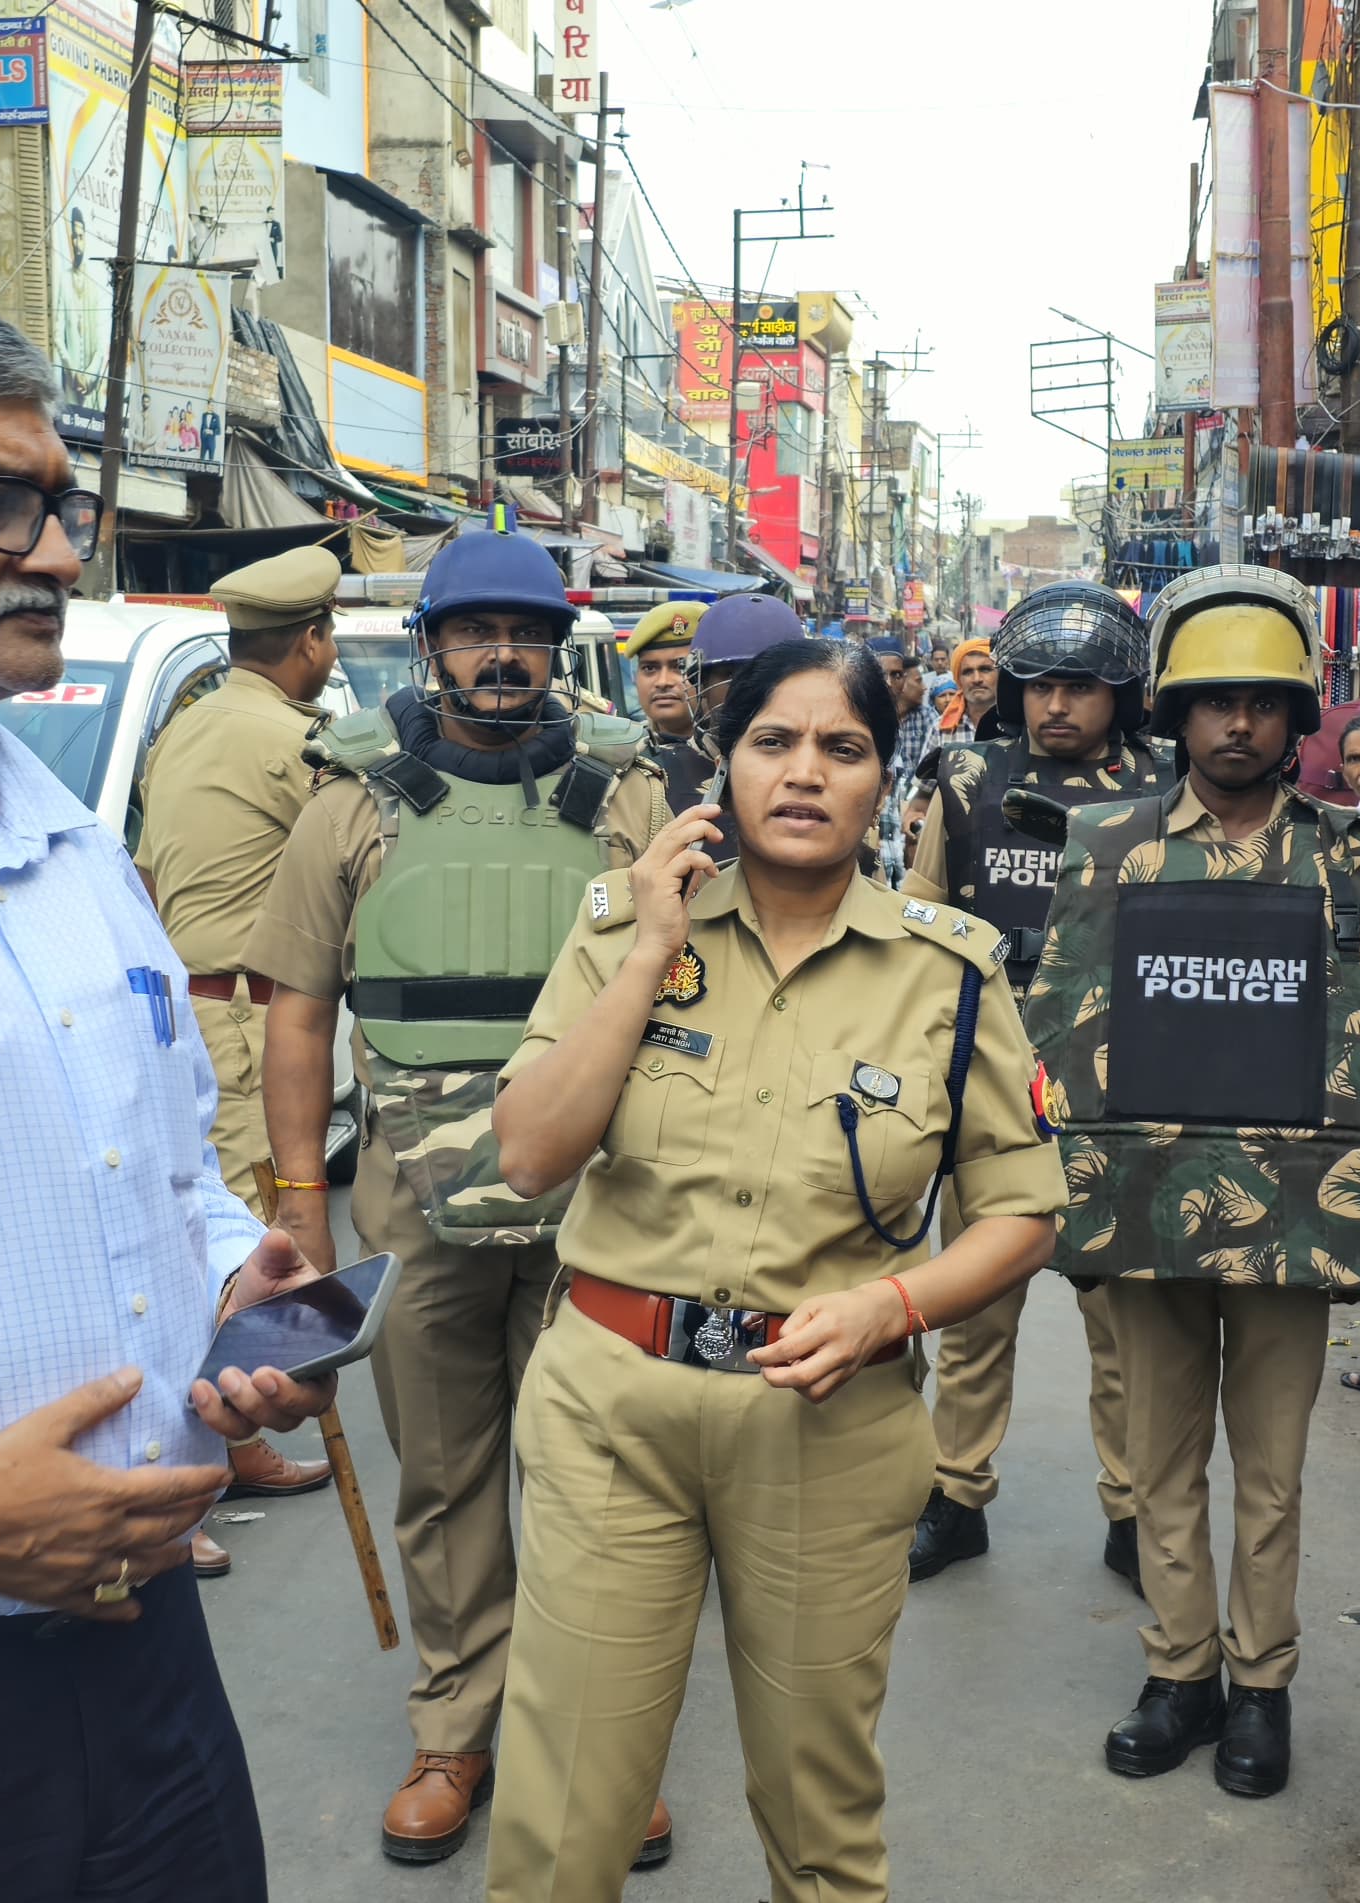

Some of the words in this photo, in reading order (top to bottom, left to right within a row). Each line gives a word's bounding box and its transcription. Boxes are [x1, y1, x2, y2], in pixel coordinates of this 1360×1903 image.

[49, 32, 90, 71] GOVIND
[197, 183, 273, 198] COLLECTION
[157, 328, 198, 343] NANAK
[354, 618, 402, 634] POLICE
[436, 804, 560, 828] POLICE
[989, 866, 1057, 888] POL
[1136, 954, 1308, 982] FATEHGARH
[1143, 976, 1300, 1003] POLICE
[650, 1033, 668, 1043] ARTI
[668, 1037, 691, 1049] SINGH
